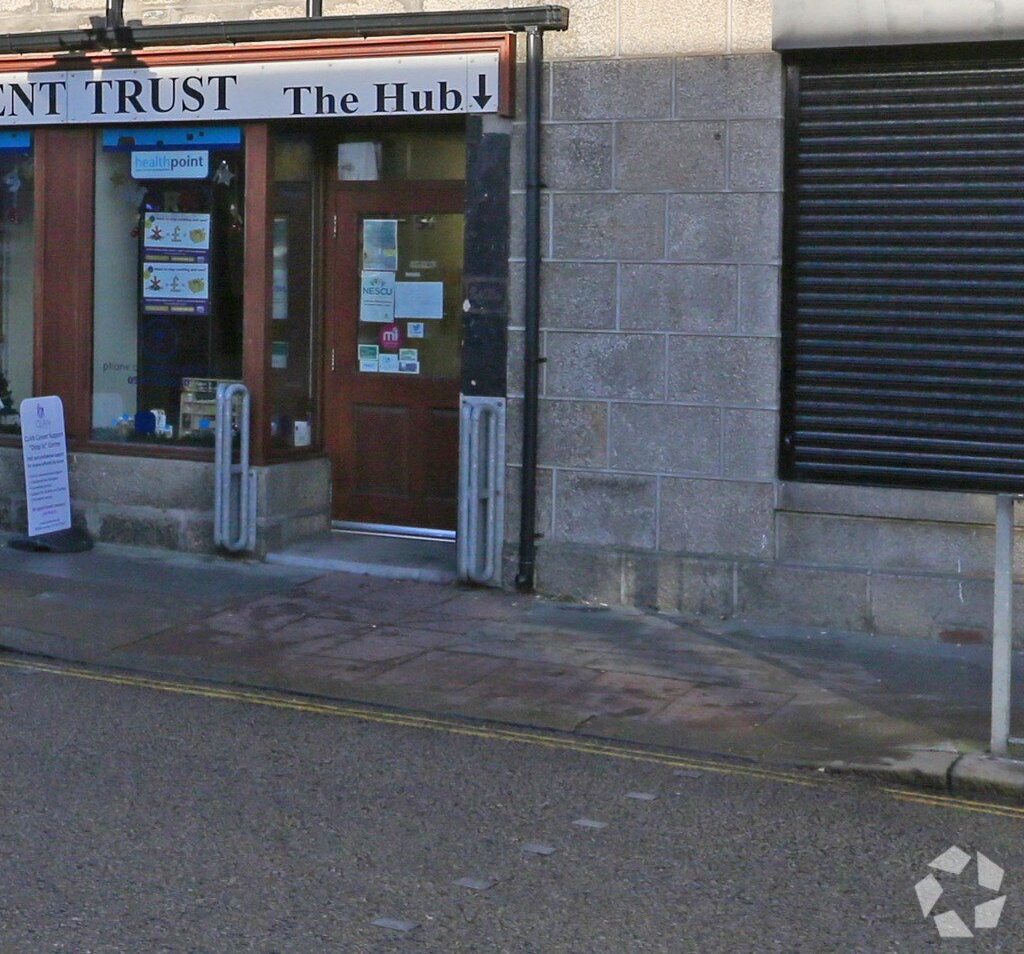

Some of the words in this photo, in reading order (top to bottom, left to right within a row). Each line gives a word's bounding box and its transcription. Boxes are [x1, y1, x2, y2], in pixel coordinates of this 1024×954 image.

[85, 75, 237, 115] TRUST
[283, 85, 360, 116] The
[372, 81, 463, 113] Hub
[134, 154, 204, 170] healthpoint
[363, 287, 392, 295] NESCU
